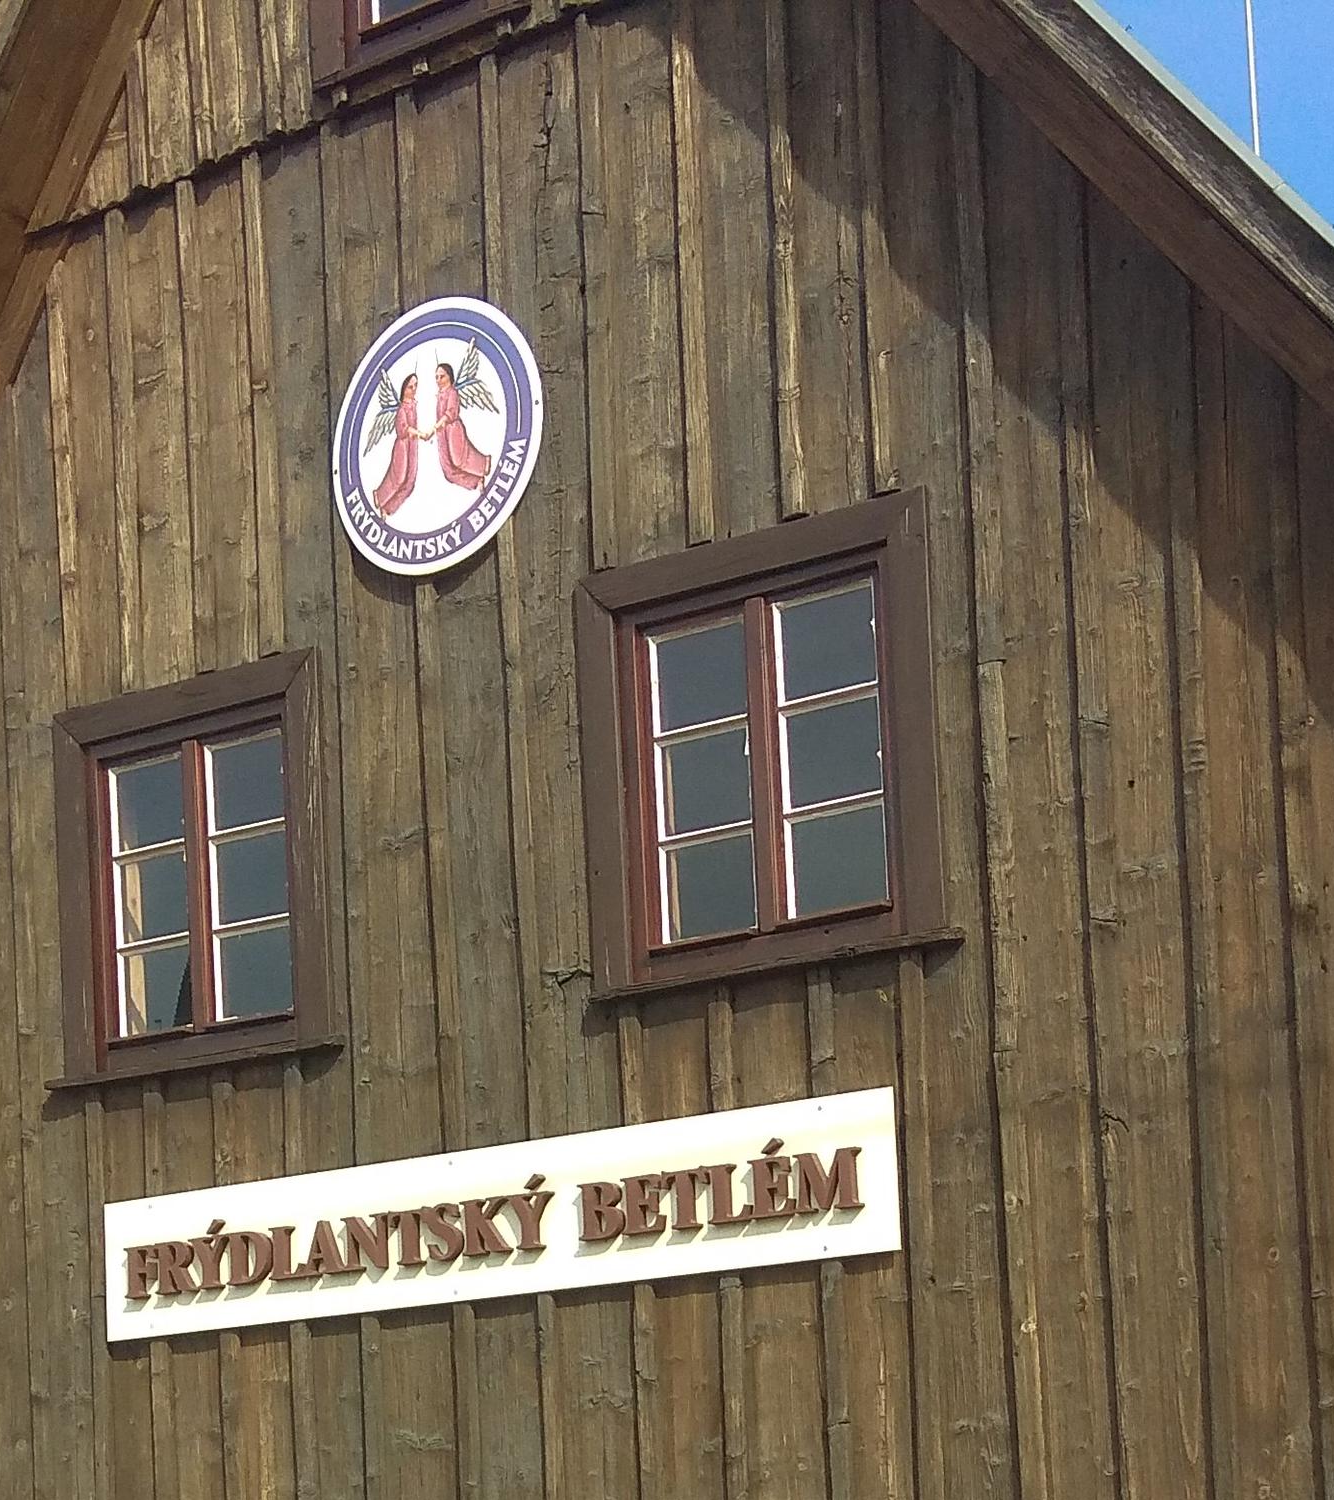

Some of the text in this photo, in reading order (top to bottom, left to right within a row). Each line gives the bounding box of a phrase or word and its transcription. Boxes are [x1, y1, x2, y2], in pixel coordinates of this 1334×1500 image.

[345, 437, 528, 560] FRÝDLANTSKÝ BETLÉM
[123, 1137, 865, 1302] FRÝDLANTSKÝ BETLÉM
